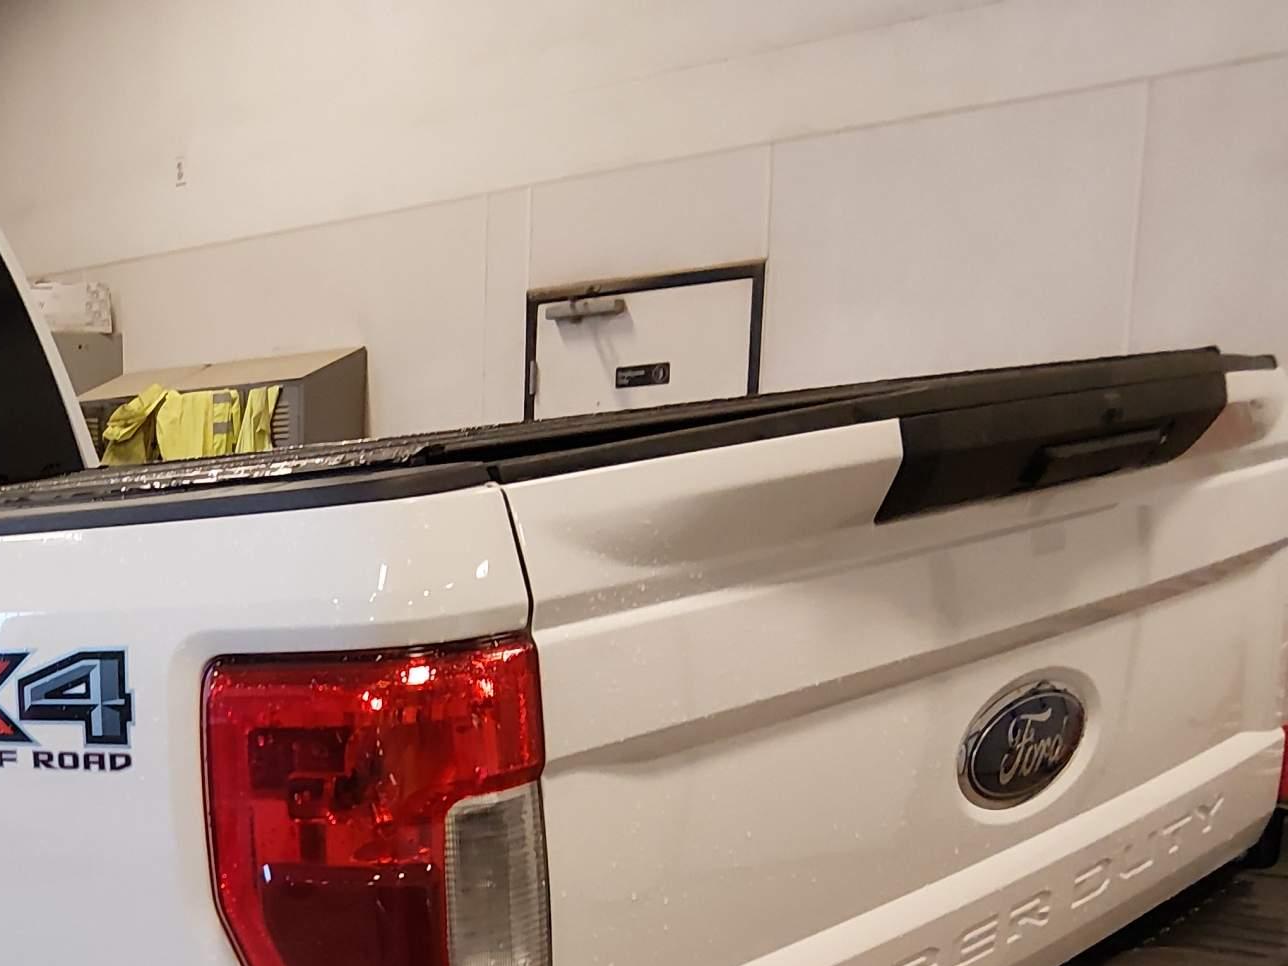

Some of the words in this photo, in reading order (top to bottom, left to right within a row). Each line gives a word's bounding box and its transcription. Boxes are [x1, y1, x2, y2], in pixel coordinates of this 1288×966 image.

[33, 751, 132, 772] ROAD
[998, 706, 1069, 786] Ford
[1069, 796, 1225, 910] DUTY
